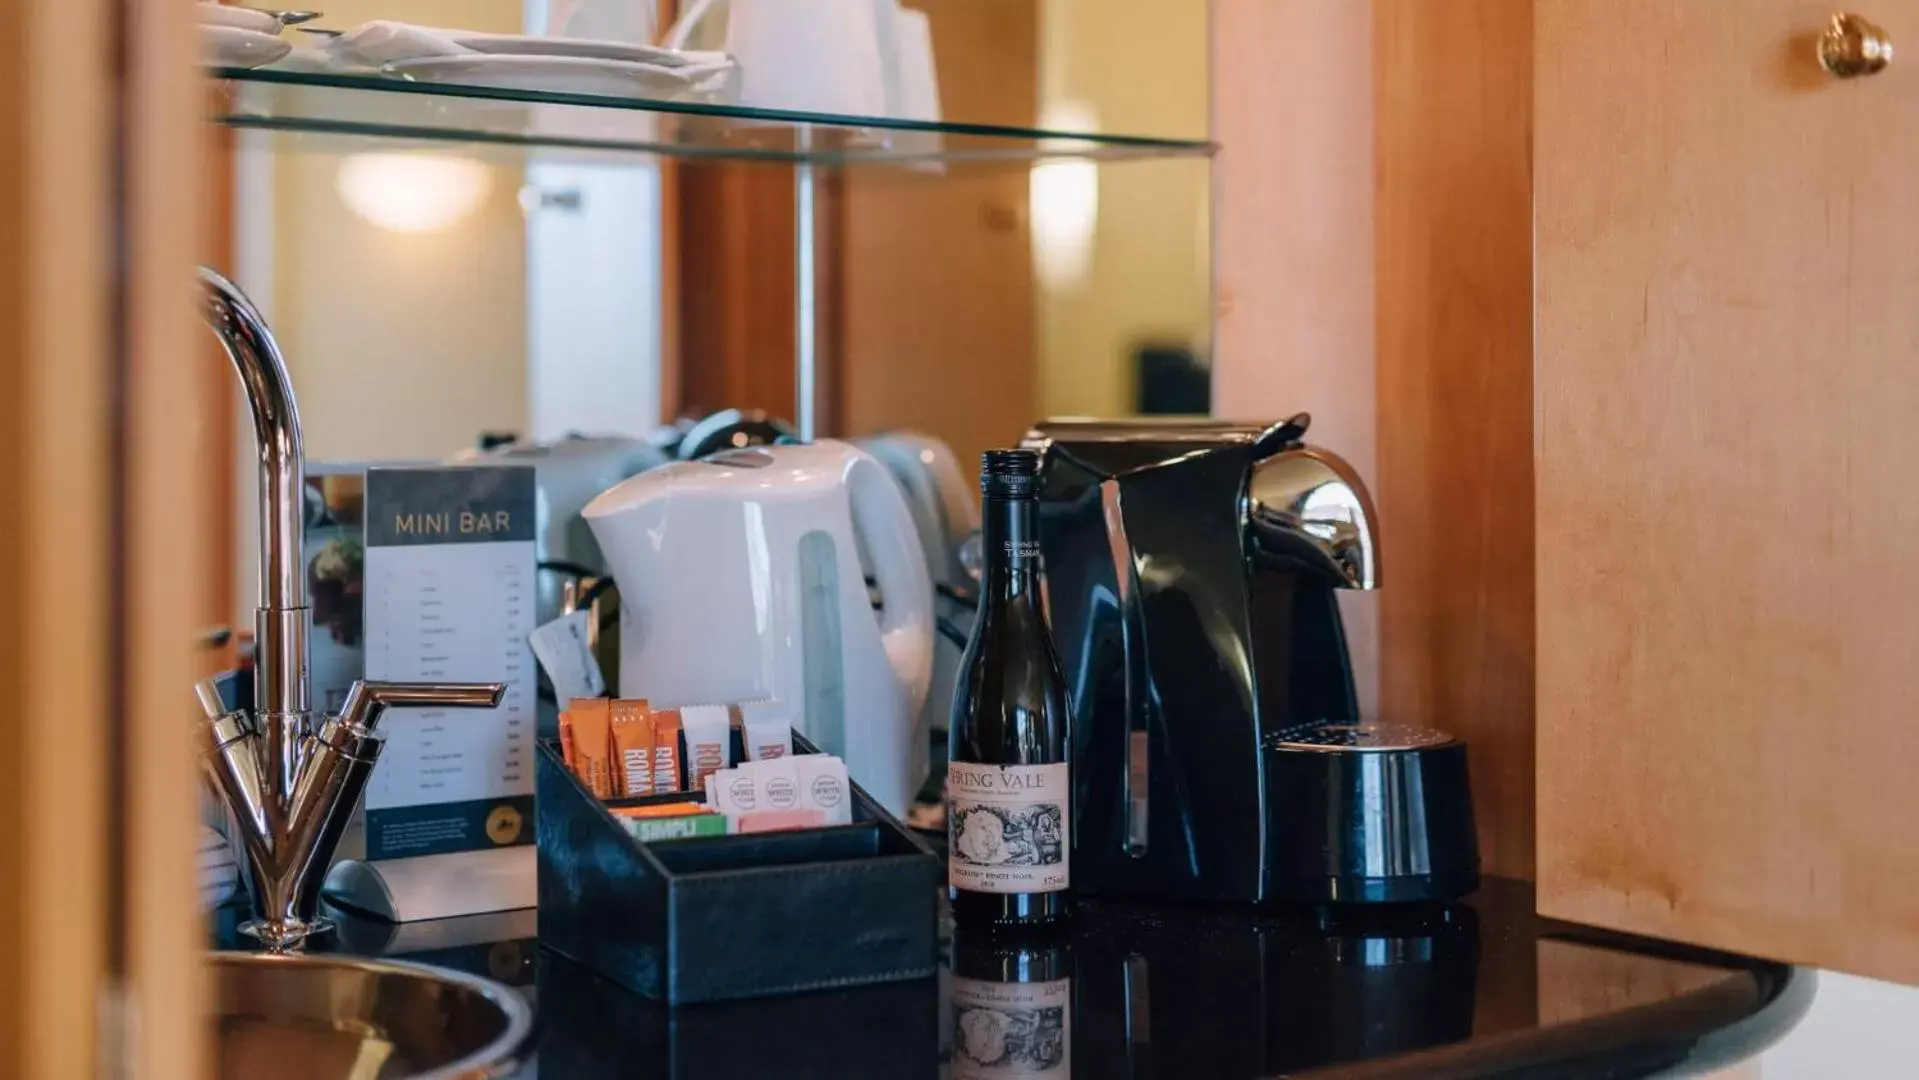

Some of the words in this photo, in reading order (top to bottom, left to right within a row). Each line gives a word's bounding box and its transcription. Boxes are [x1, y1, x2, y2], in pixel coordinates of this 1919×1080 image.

[395, 513, 450, 534] MINI
[459, 510, 511, 533] BAR
[624, 749, 652, 794] ROMA
[654, 746, 678, 793] ROMA
[1000, 772, 1046, 788] VALE
